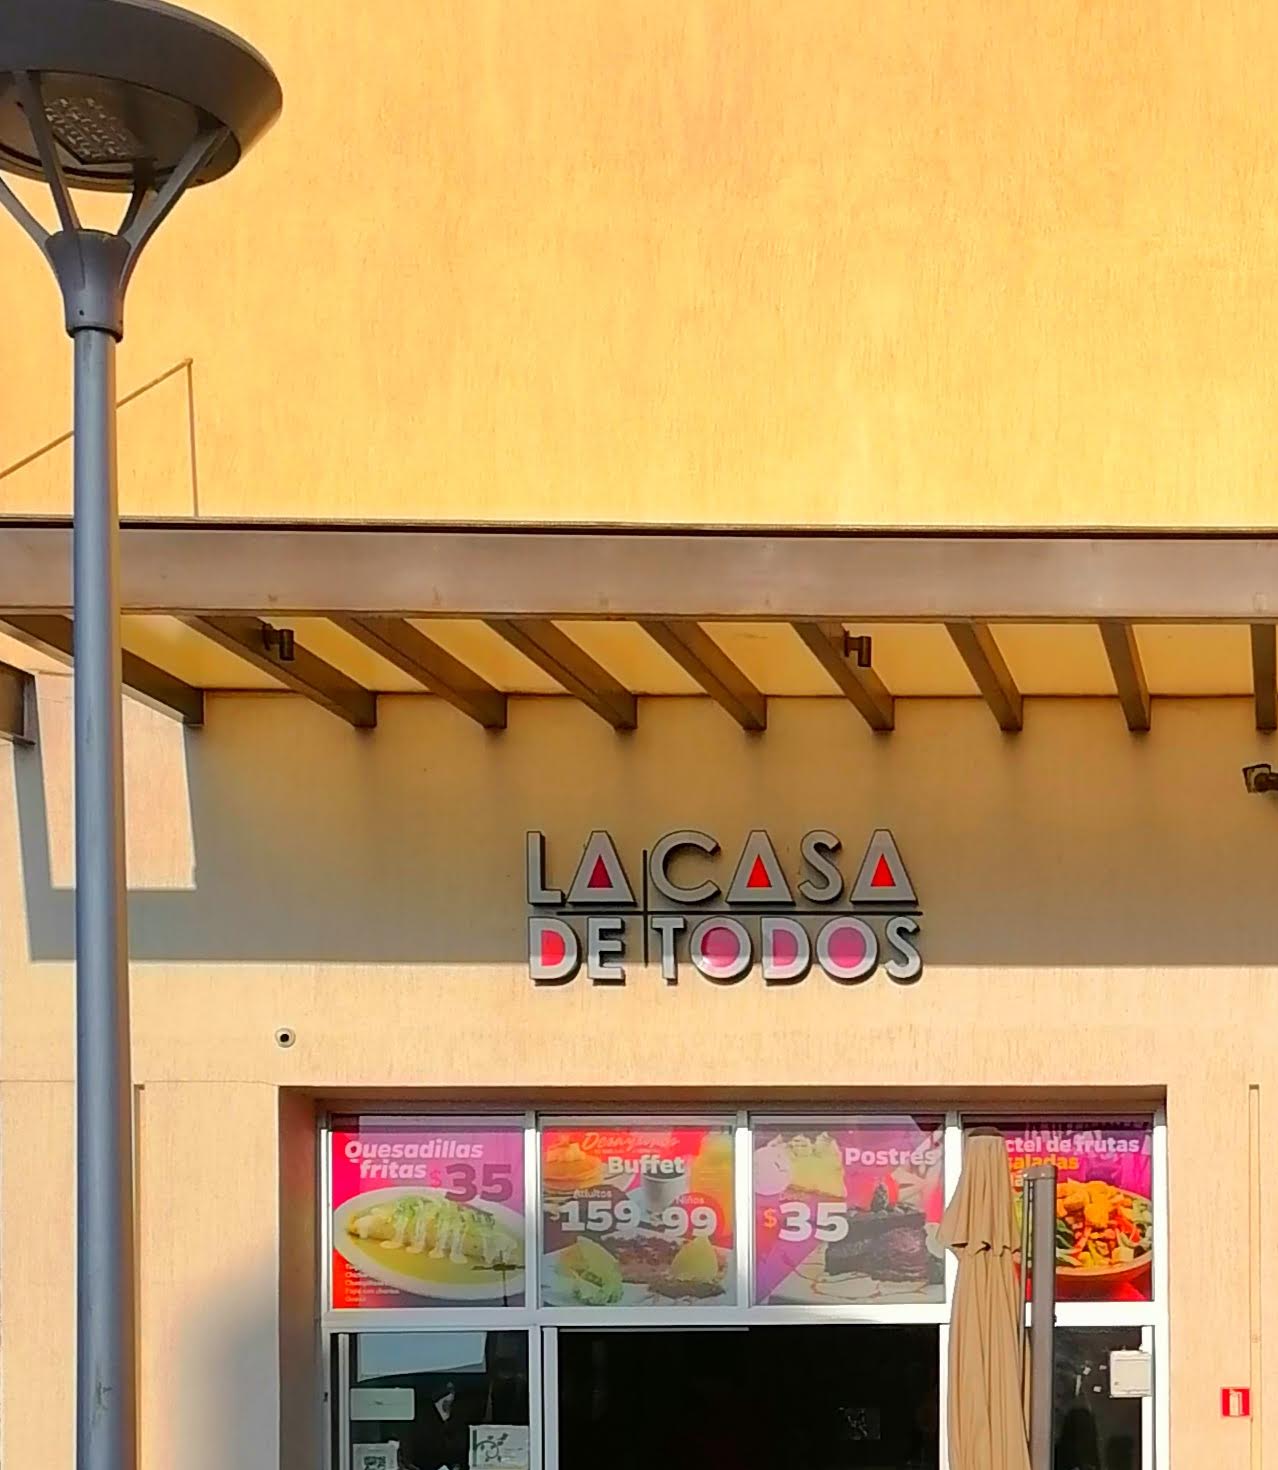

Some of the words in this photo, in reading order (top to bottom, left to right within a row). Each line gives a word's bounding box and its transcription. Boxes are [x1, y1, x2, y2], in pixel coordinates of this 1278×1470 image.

[526, 829, 637, 904] LA
[648, 829, 919, 904] CASA
[527, 915, 627, 983] DE
[650, 914, 923, 983] TODOS
[344, 1139, 484, 1163] Quesadillas
[1046, 1136, 1072, 1153] de
[1075, 1135, 1140, 1153] frutas
[607, 1154, 685, 1175] Buffet
[844, 1146, 938, 1167] Postres
[359, 1158, 427, 1180] fritas
[573, 1189, 613, 1199] Adultos
[763, 1201, 849, 1243] $35
